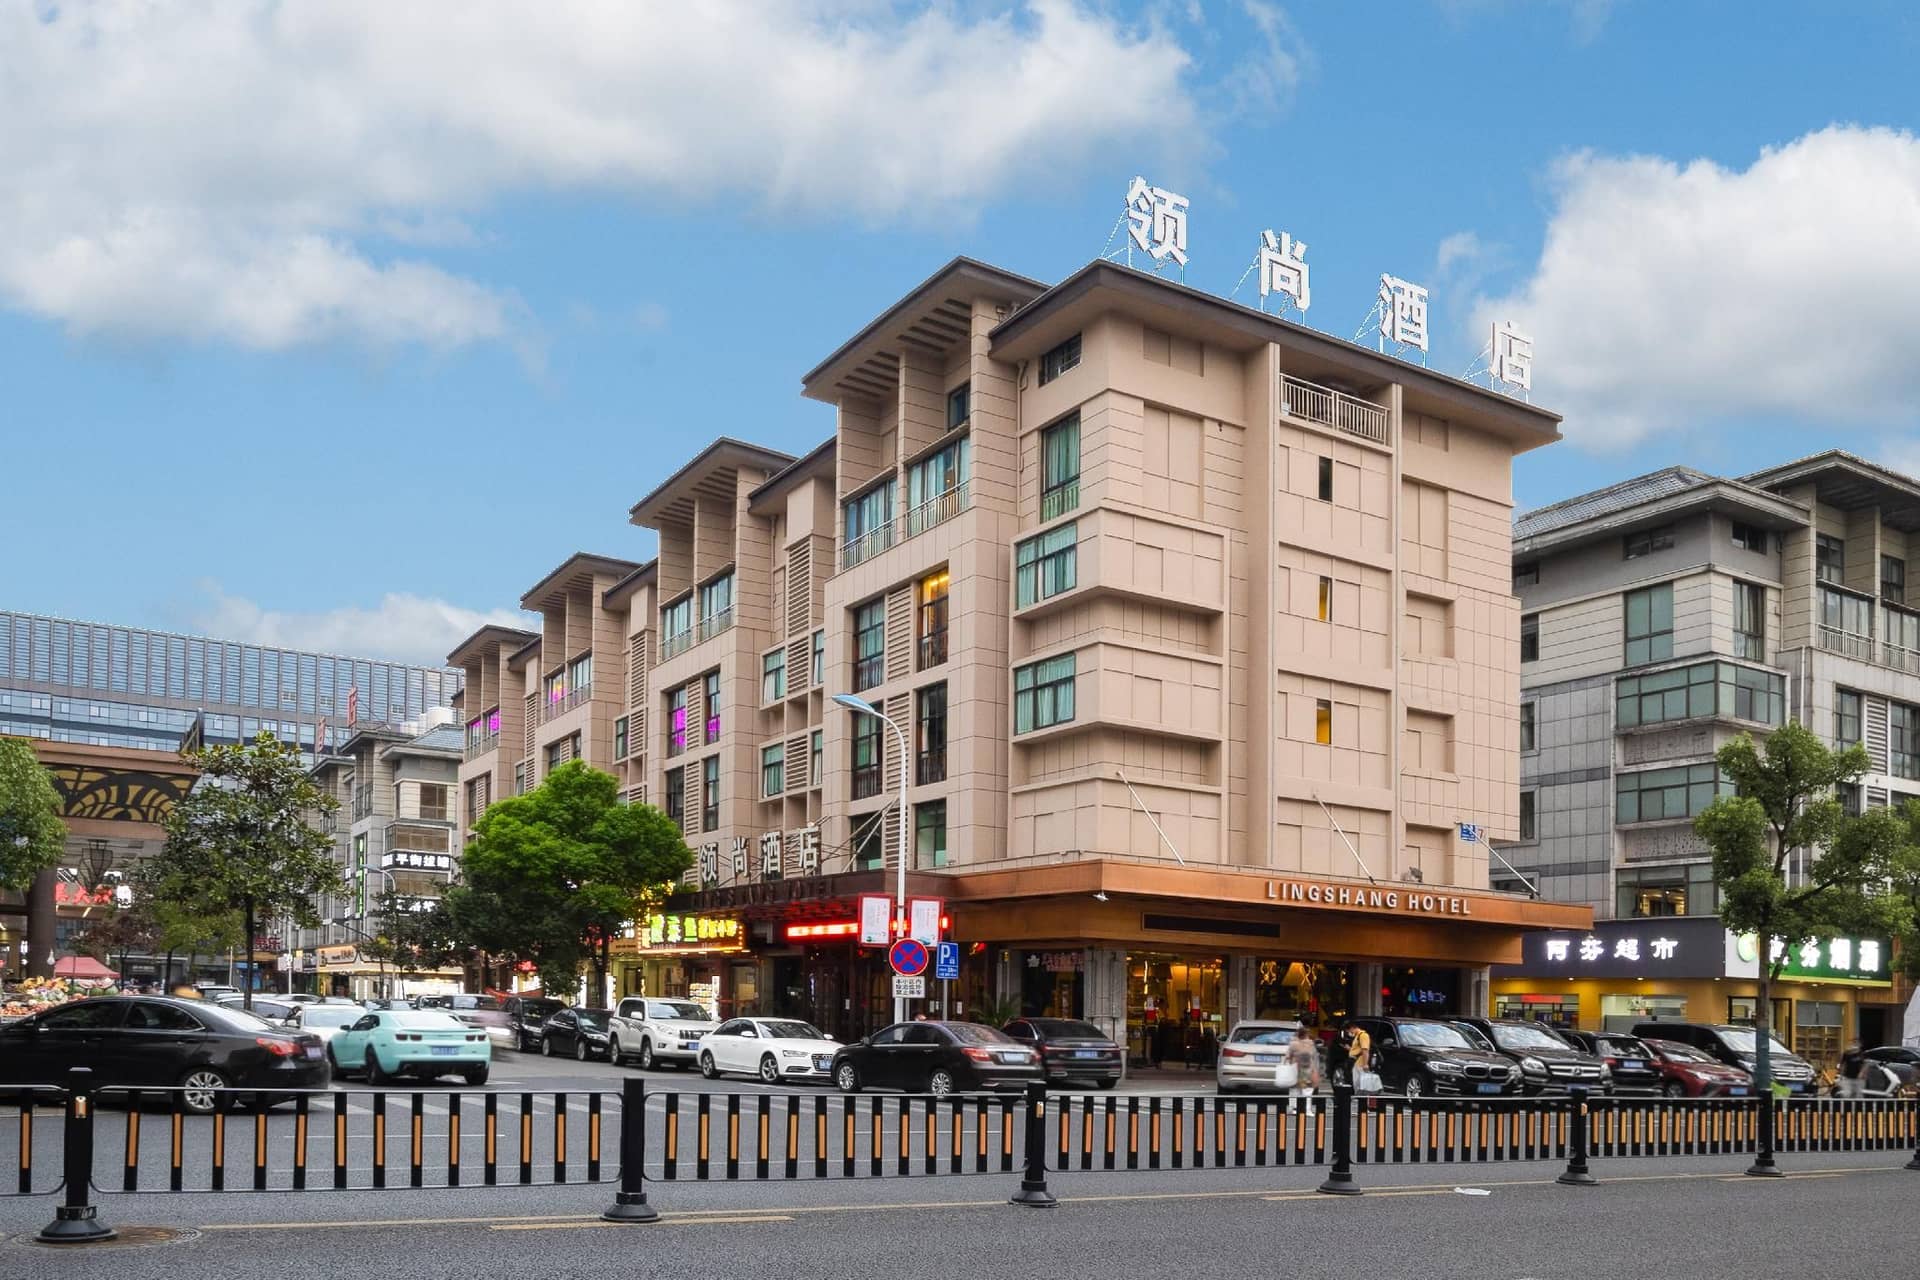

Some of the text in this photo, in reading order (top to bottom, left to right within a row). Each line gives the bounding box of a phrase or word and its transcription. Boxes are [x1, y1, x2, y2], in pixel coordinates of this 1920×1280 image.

[1126, 176, 1533, 391] 领尚酒店
[700, 824, 820, 882] 领尚酒店
[1267, 880, 1472, 915] LINGSHANG HOTEL
[940, 944, 951, 965] P
[1546, 937, 1678, 961] 阿芬超市
